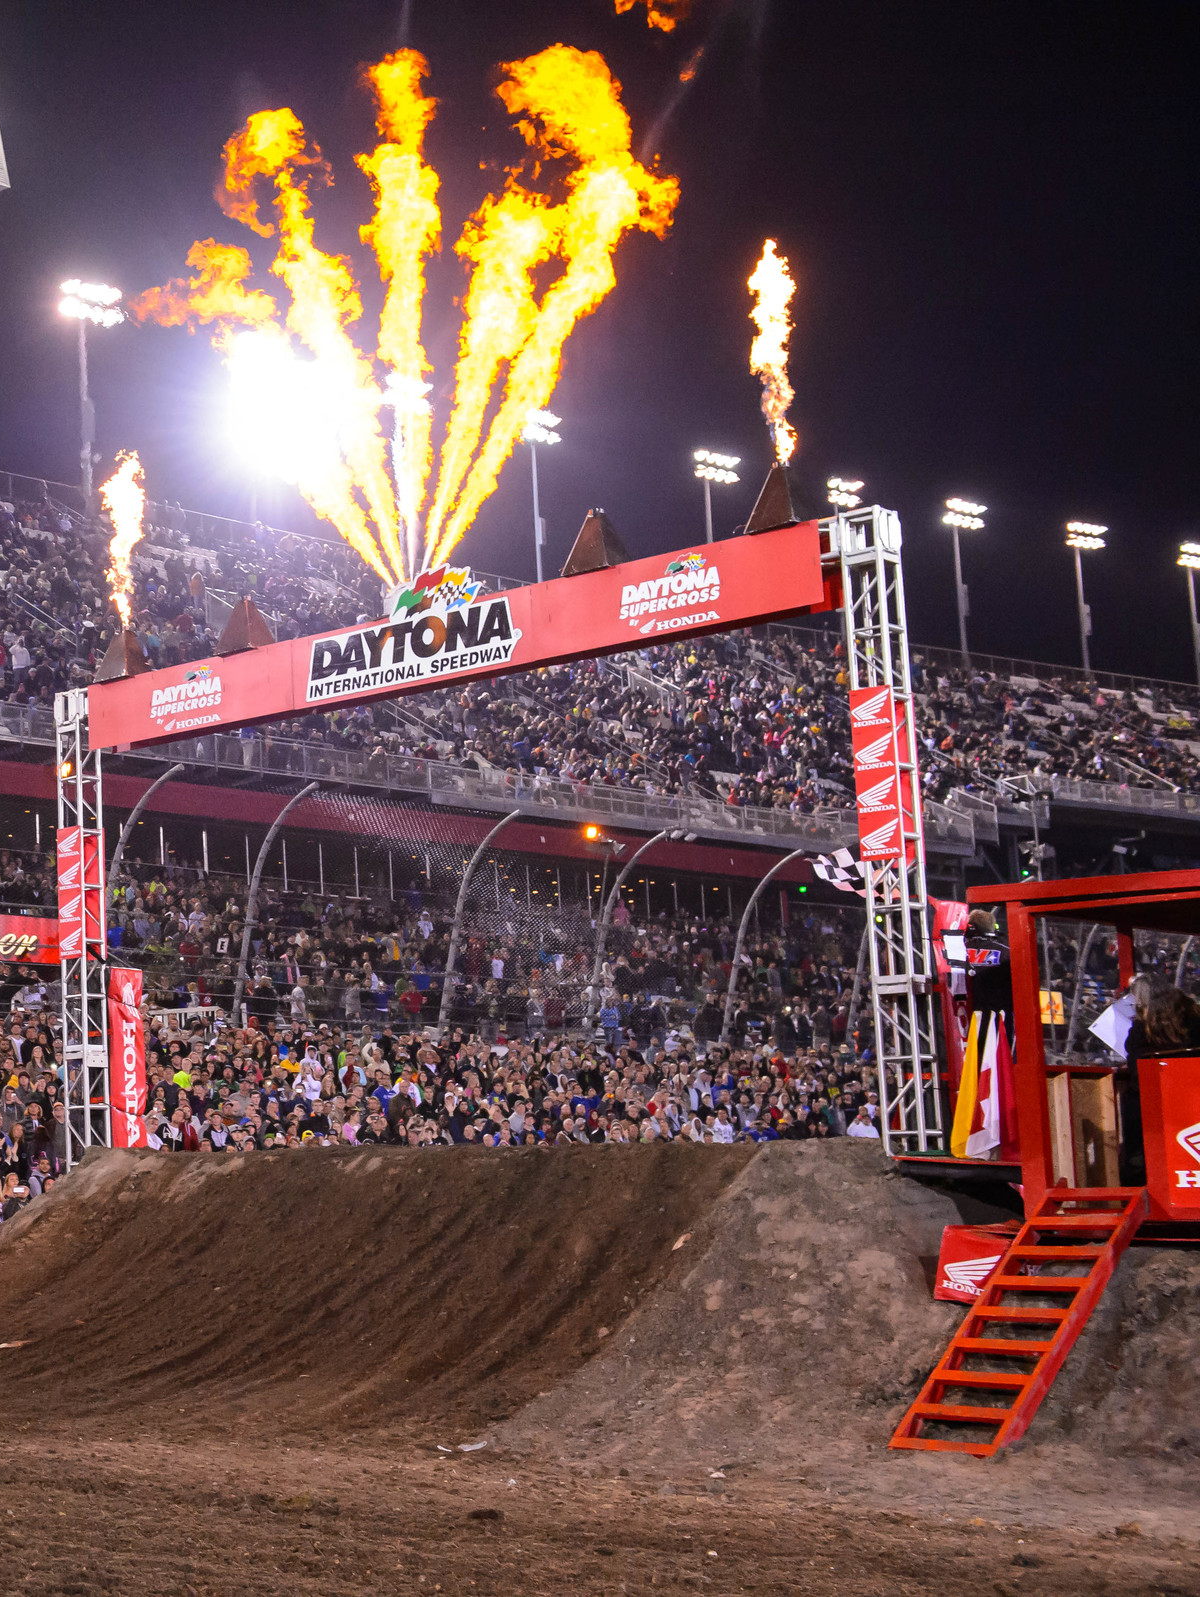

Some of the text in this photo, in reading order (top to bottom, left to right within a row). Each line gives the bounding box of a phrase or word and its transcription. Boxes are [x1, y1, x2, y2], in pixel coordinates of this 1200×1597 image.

[620, 566, 721, 606] DAYTONA
[619, 585, 721, 620] SUPERCROSS
[655, 610, 721, 631] HONDA
[310, 599, 513, 682] DAYTONA
[309, 643, 512, 699] INTERNATIONAL SPEEDWAY
[151, 676, 222, 707] DAYTONA
[149, 692, 222, 719] SUPERCROSS
[175, 713, 222, 729] HONDA
[853, 717, 891, 728] HONDA
[856, 760, 895, 771] HONDA
[859, 803, 897, 814] HONDA
[862, 846, 900, 857] HONDA
